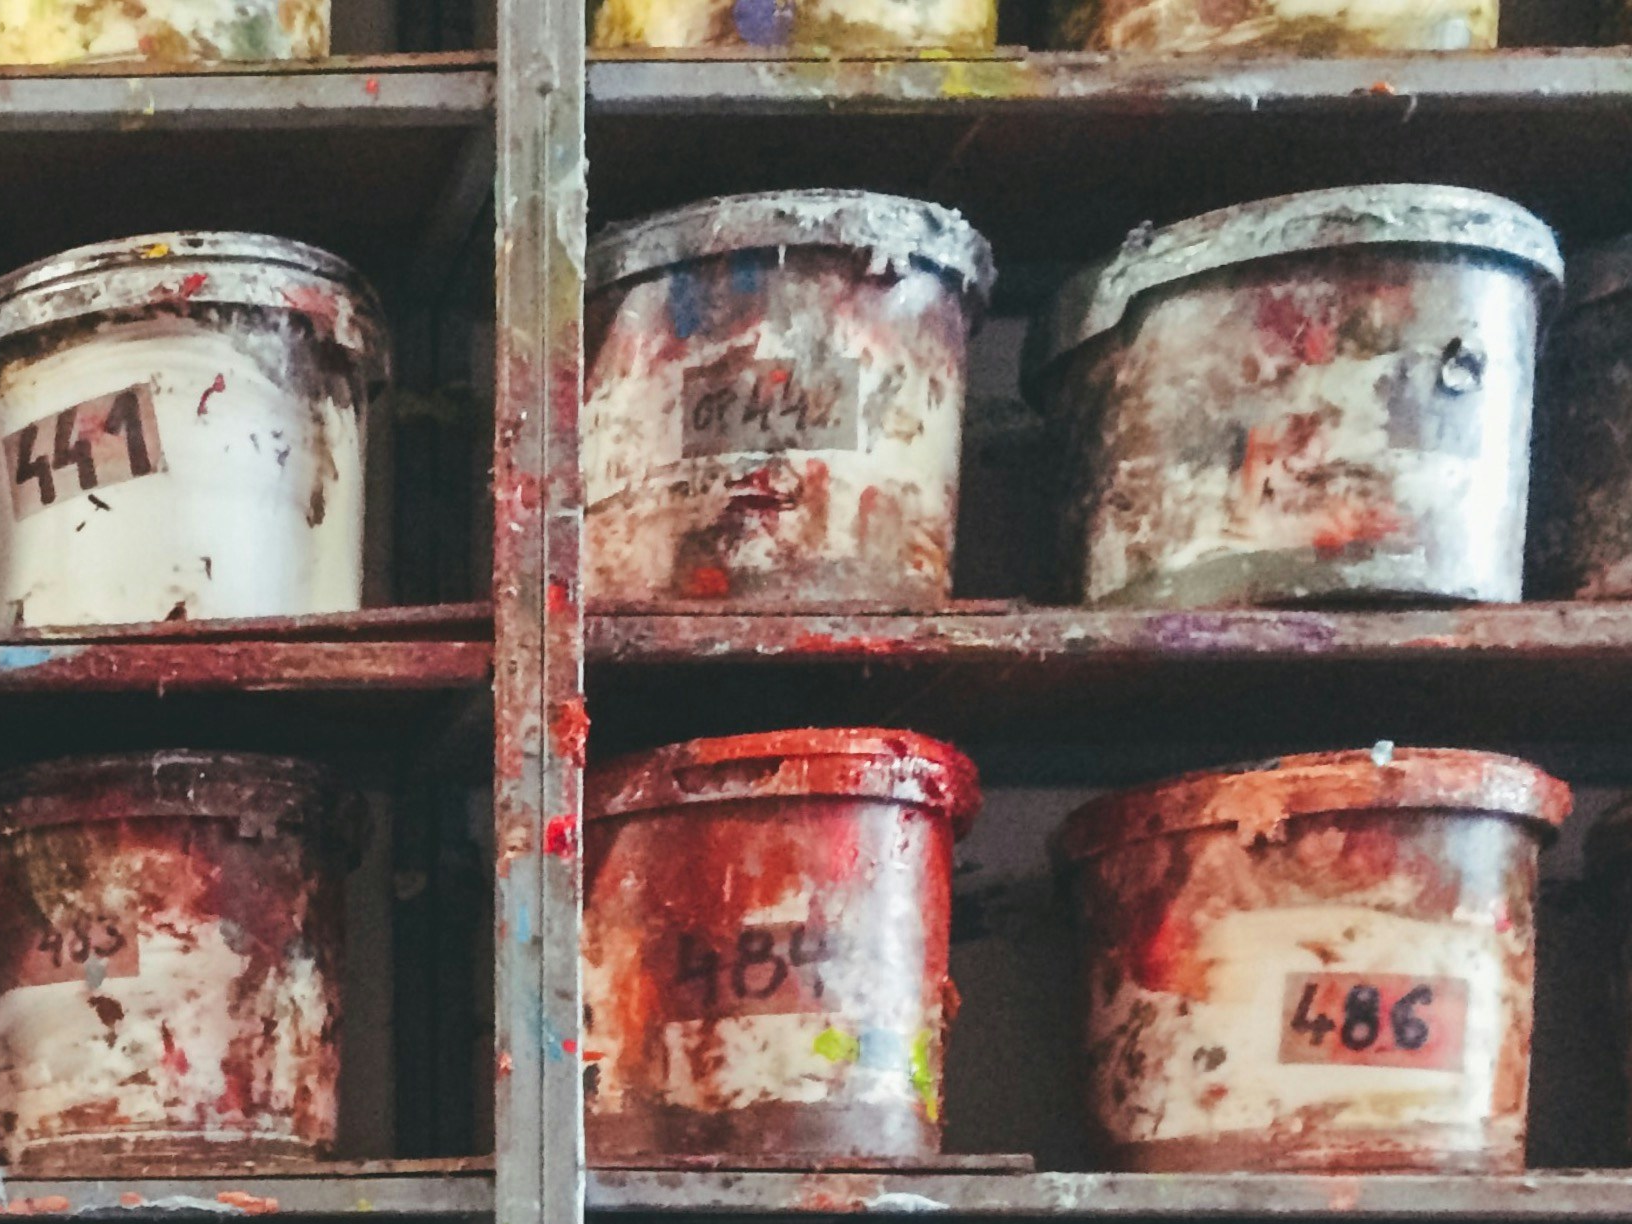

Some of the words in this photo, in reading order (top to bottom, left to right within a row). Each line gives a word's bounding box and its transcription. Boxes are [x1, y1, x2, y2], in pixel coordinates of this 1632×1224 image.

[15, 389, 151, 506] 441
[676, 922, 836, 1004] 484
[1290, 984, 1435, 1050] 486
